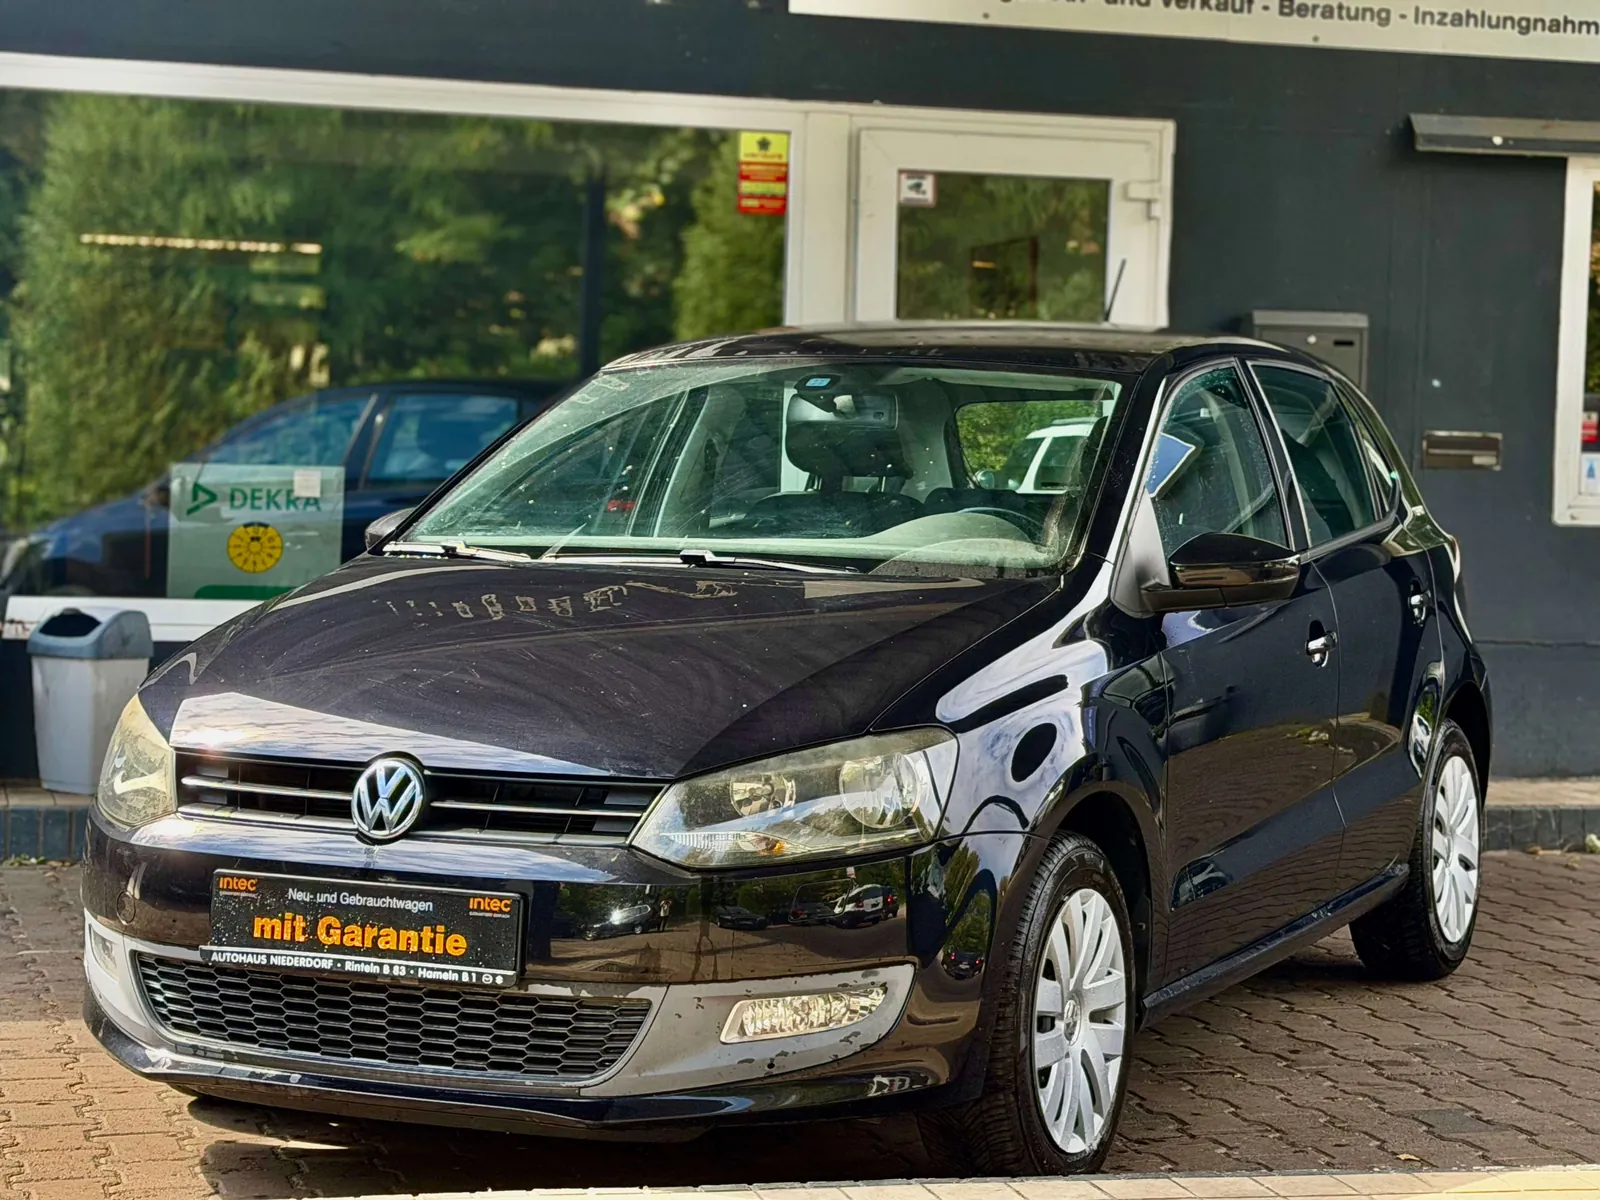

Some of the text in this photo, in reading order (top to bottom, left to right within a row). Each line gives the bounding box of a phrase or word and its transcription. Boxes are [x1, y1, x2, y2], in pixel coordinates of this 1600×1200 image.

[1278, 0, 1392, 27] Beratung
[1414, 5, 1600, 36] Inzahlungnahm
[229, 487, 321, 512] DEKRA
[218, 876, 256, 891] intec
[288, 887, 433, 912] Neu- und Gebrauchtwagen
[469, 896, 511, 912] intec
[253, 912, 468, 956] mit Garantie
[211, 952, 267, 965] AUTOHAUS
[270, 955, 333, 970] NIEDERDORF
[345, 960, 380, 973] Rinteln
[382, 963, 391, 976] B
[392, 964, 406, 977] 83
[418, 967, 459, 981] Hameln
[461, 973, 470, 983] B
